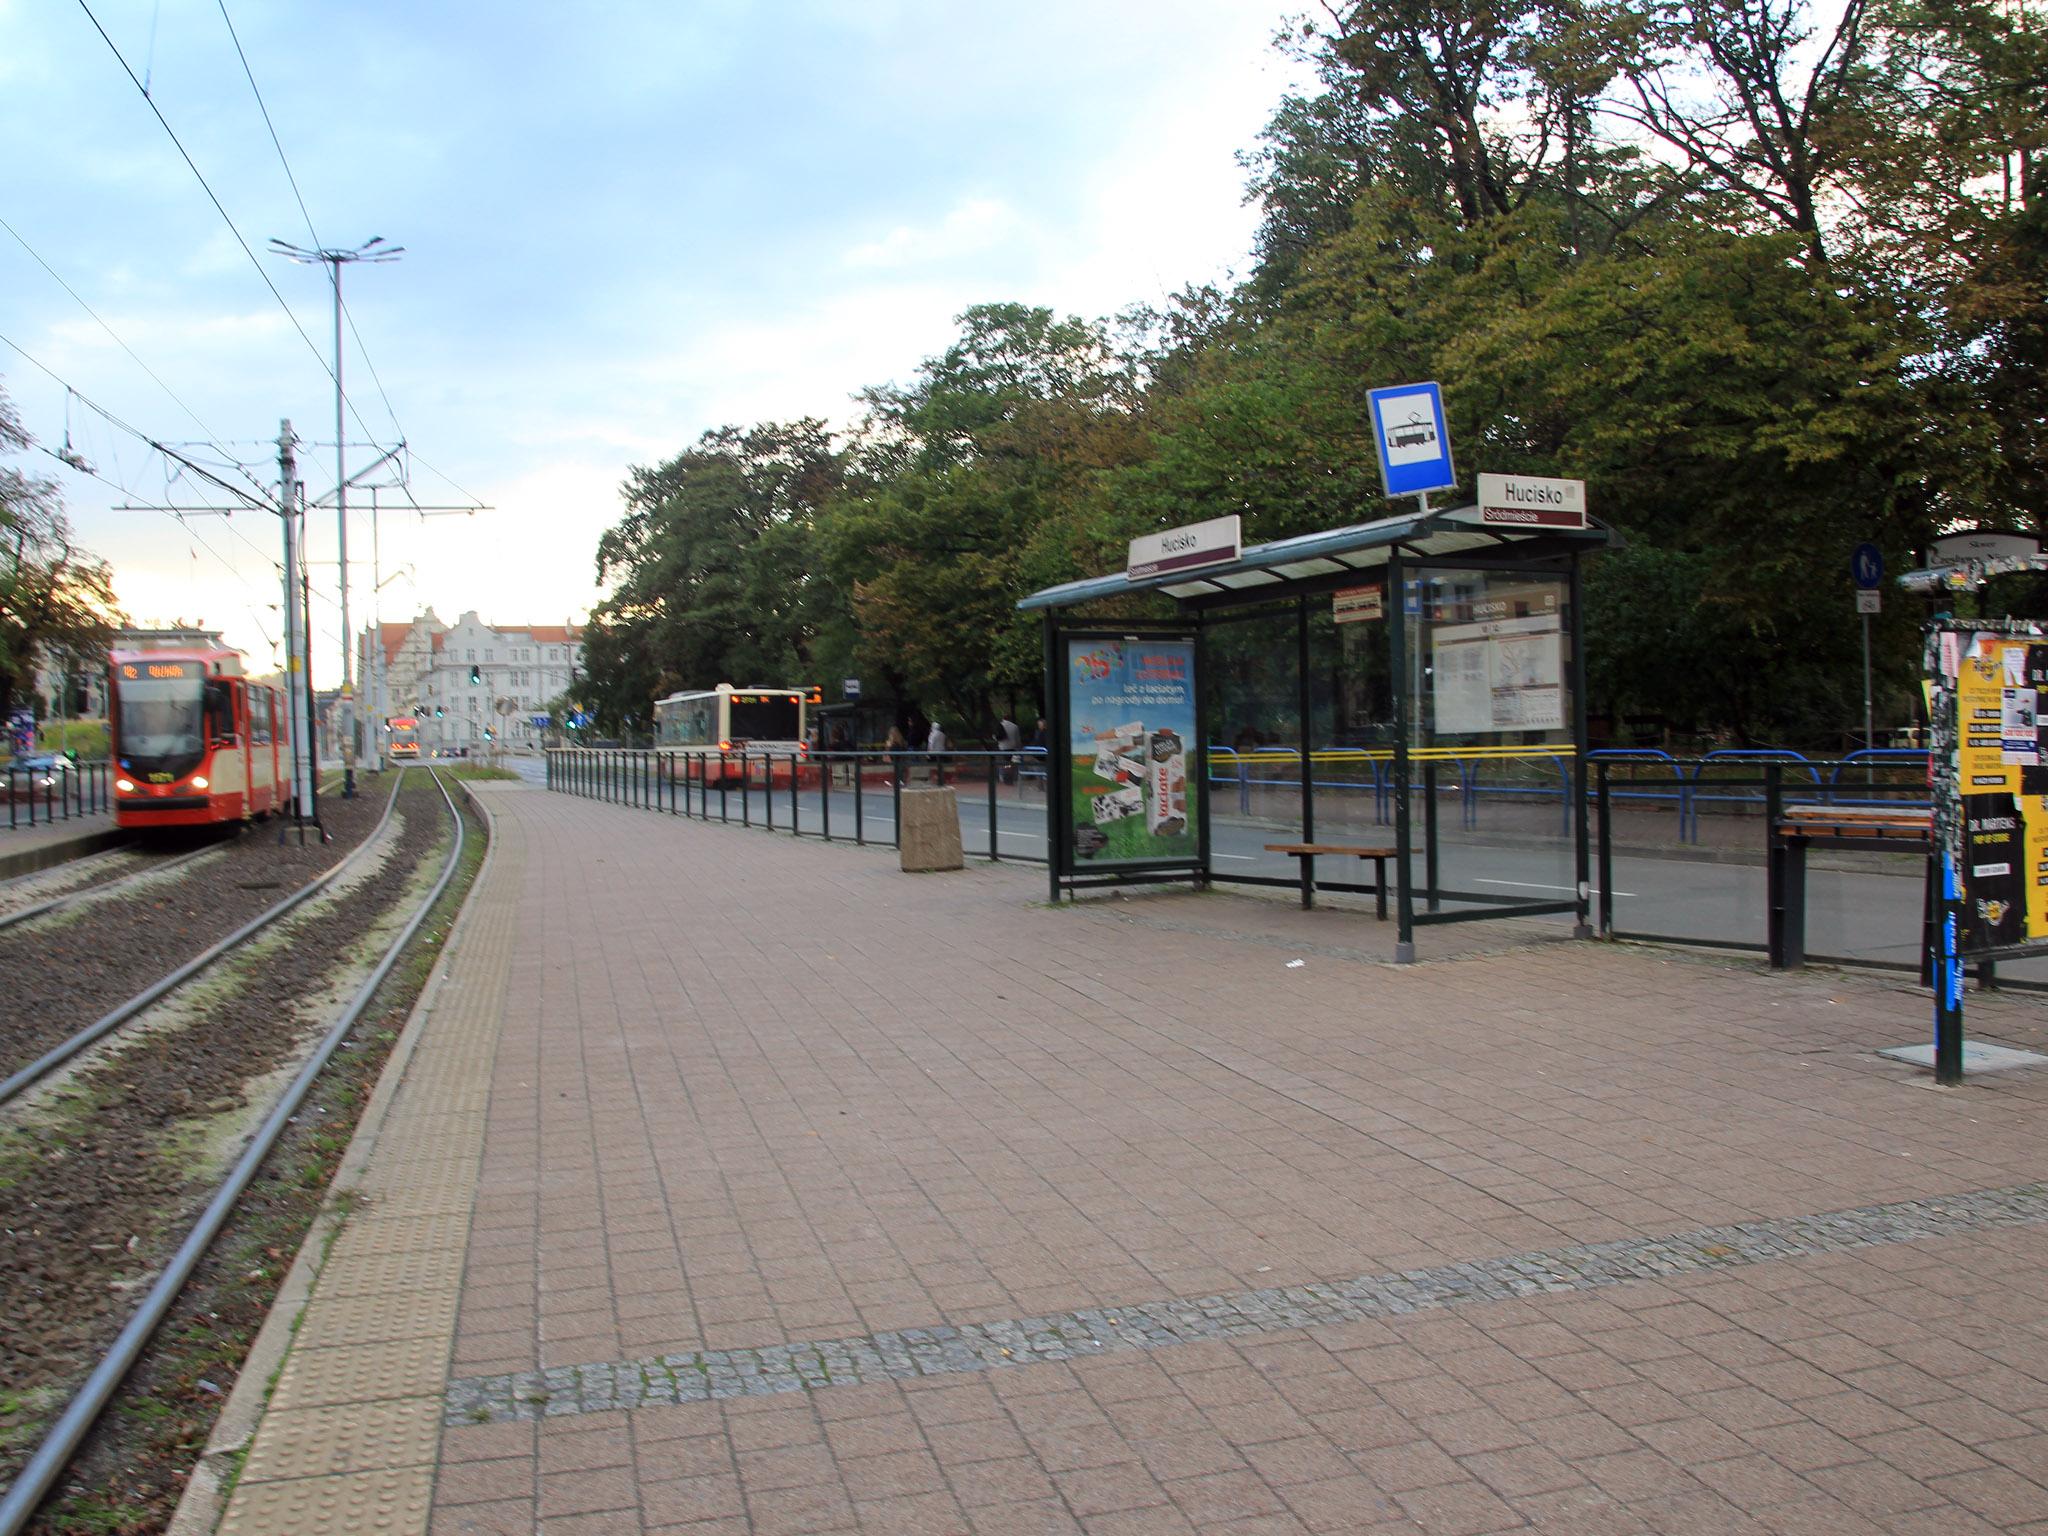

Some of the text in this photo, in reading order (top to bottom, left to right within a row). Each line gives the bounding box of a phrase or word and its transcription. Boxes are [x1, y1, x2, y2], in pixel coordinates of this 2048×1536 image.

[1505, 482, 1563, 504] Hucisko
[1161, 532, 1197, 554] Hucisko
[1982, 816, 2016, 831] MARTENS
